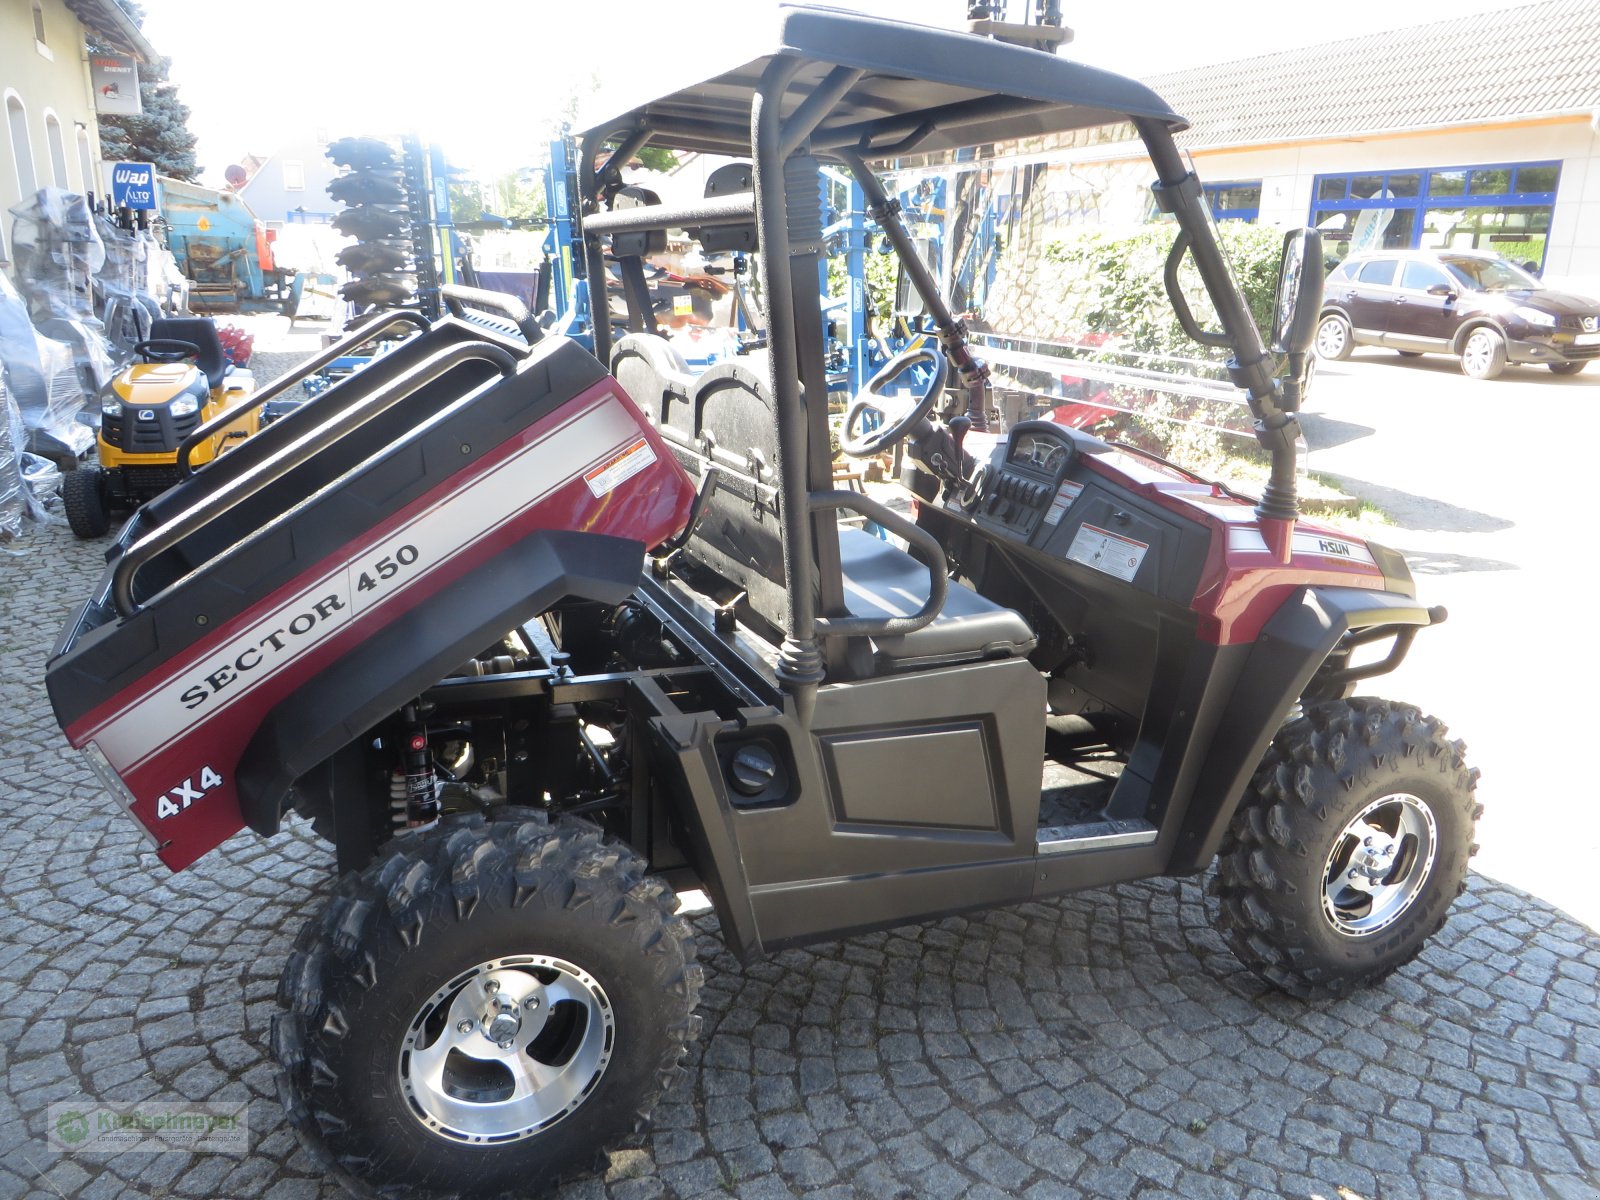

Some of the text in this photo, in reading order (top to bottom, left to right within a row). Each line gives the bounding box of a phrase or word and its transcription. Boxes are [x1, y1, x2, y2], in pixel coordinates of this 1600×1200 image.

[115, 169, 149, 186] Wap
[1318, 540, 1350, 556] HSUN
[180, 544, 420, 710] SECTOR 450
[156, 765, 224, 820] 4X4
